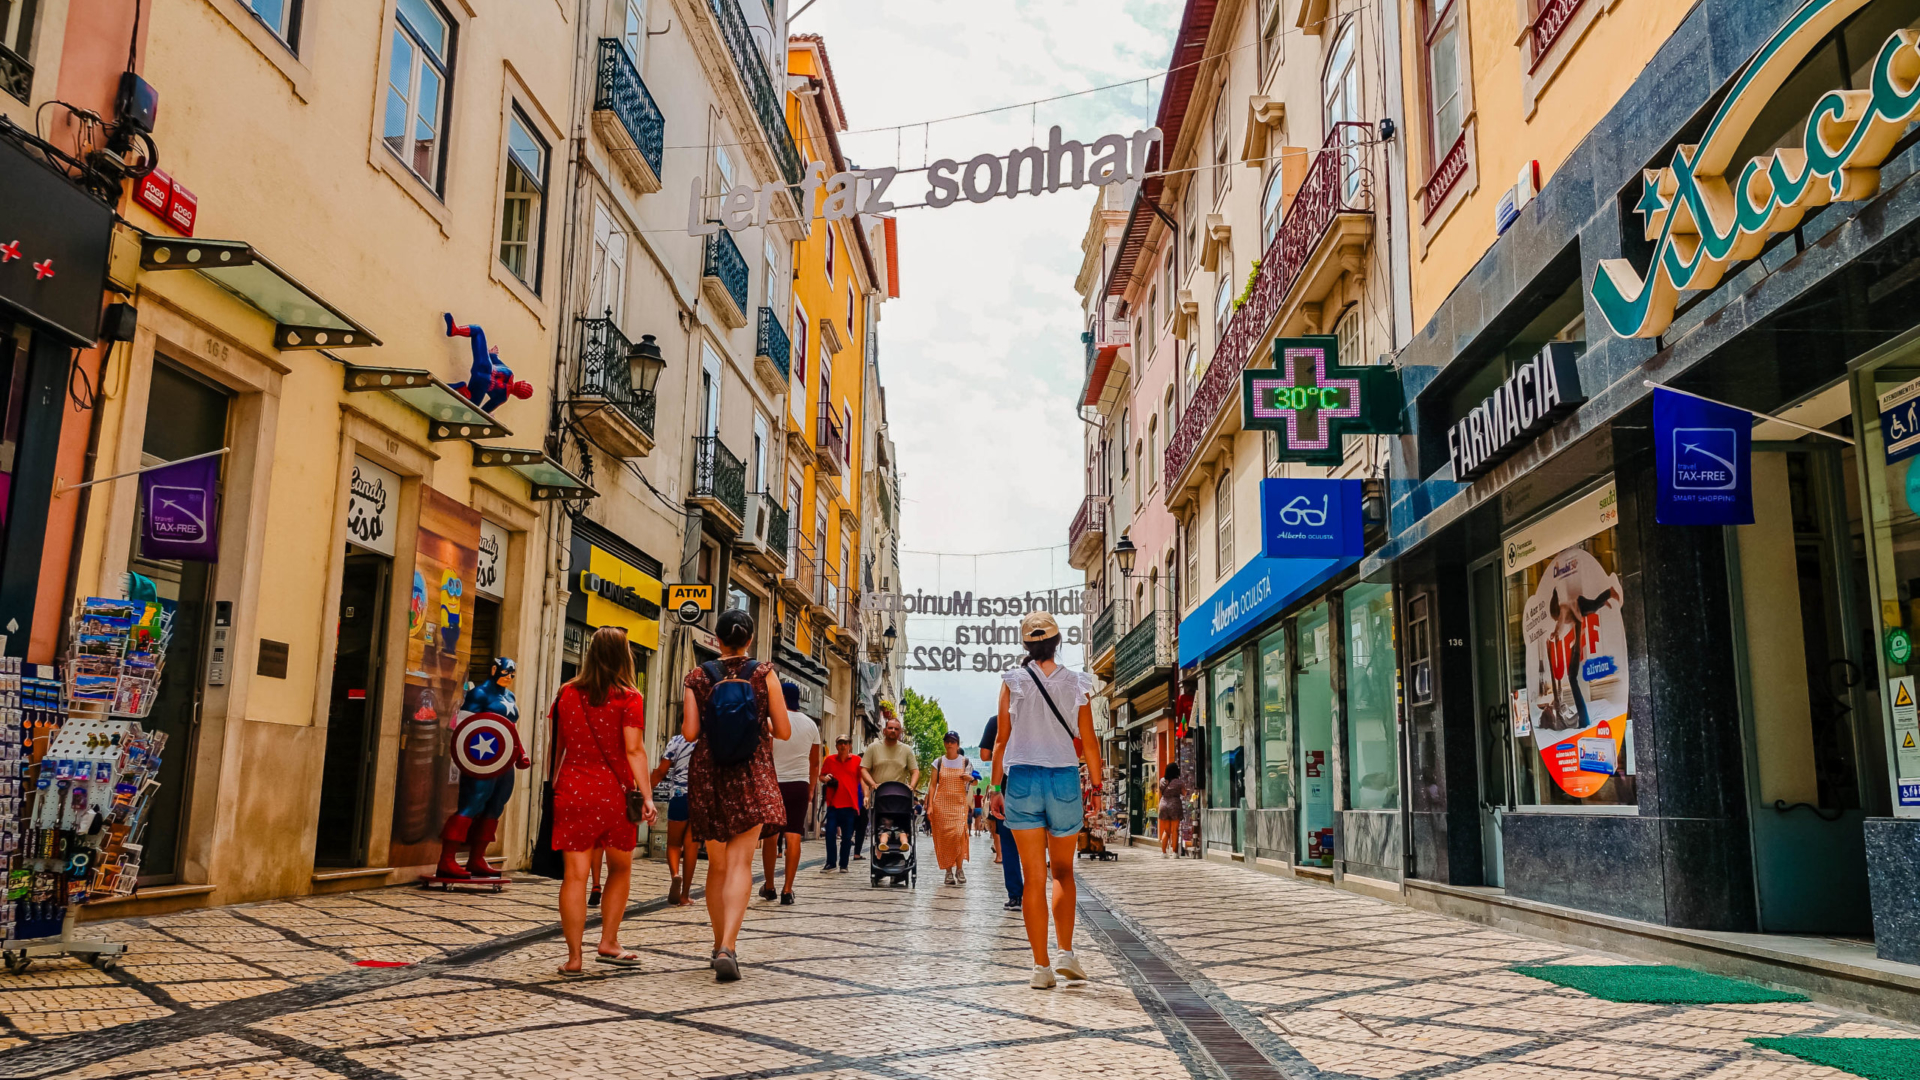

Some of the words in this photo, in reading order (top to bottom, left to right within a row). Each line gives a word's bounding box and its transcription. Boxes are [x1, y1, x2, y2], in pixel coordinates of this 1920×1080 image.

[688, 175, 787, 238] Ler
[802, 160, 898, 225] faz
[925, 125, 1164, 209] sonhar
[145, 181, 165, 200] FOGO
[174, 202, 192, 220] FOGO
[206, 338, 229, 362] 165
[1274, 386, 1339, 410] 30°C
[1447, 342, 1561, 483] FARMÁCIA
[1677, 471, 1726, 481] TAX-FREE
[1673, 494, 1696, 502] SMART
[1697, 494, 1736, 502] SHOPPING
[154, 522, 198, 534] TAX-FREE
[1276, 530, 1307, 540] Alberto
[674, 588, 707, 598] ATM
[1210, 590, 1240, 637] Alberto
[1448, 638, 1463, 647] 136
[1546, 613, 1600, 681] UFF
[1586, 661, 1610, 676] aliviou
[1597, 726, 1610, 736] NOVO
